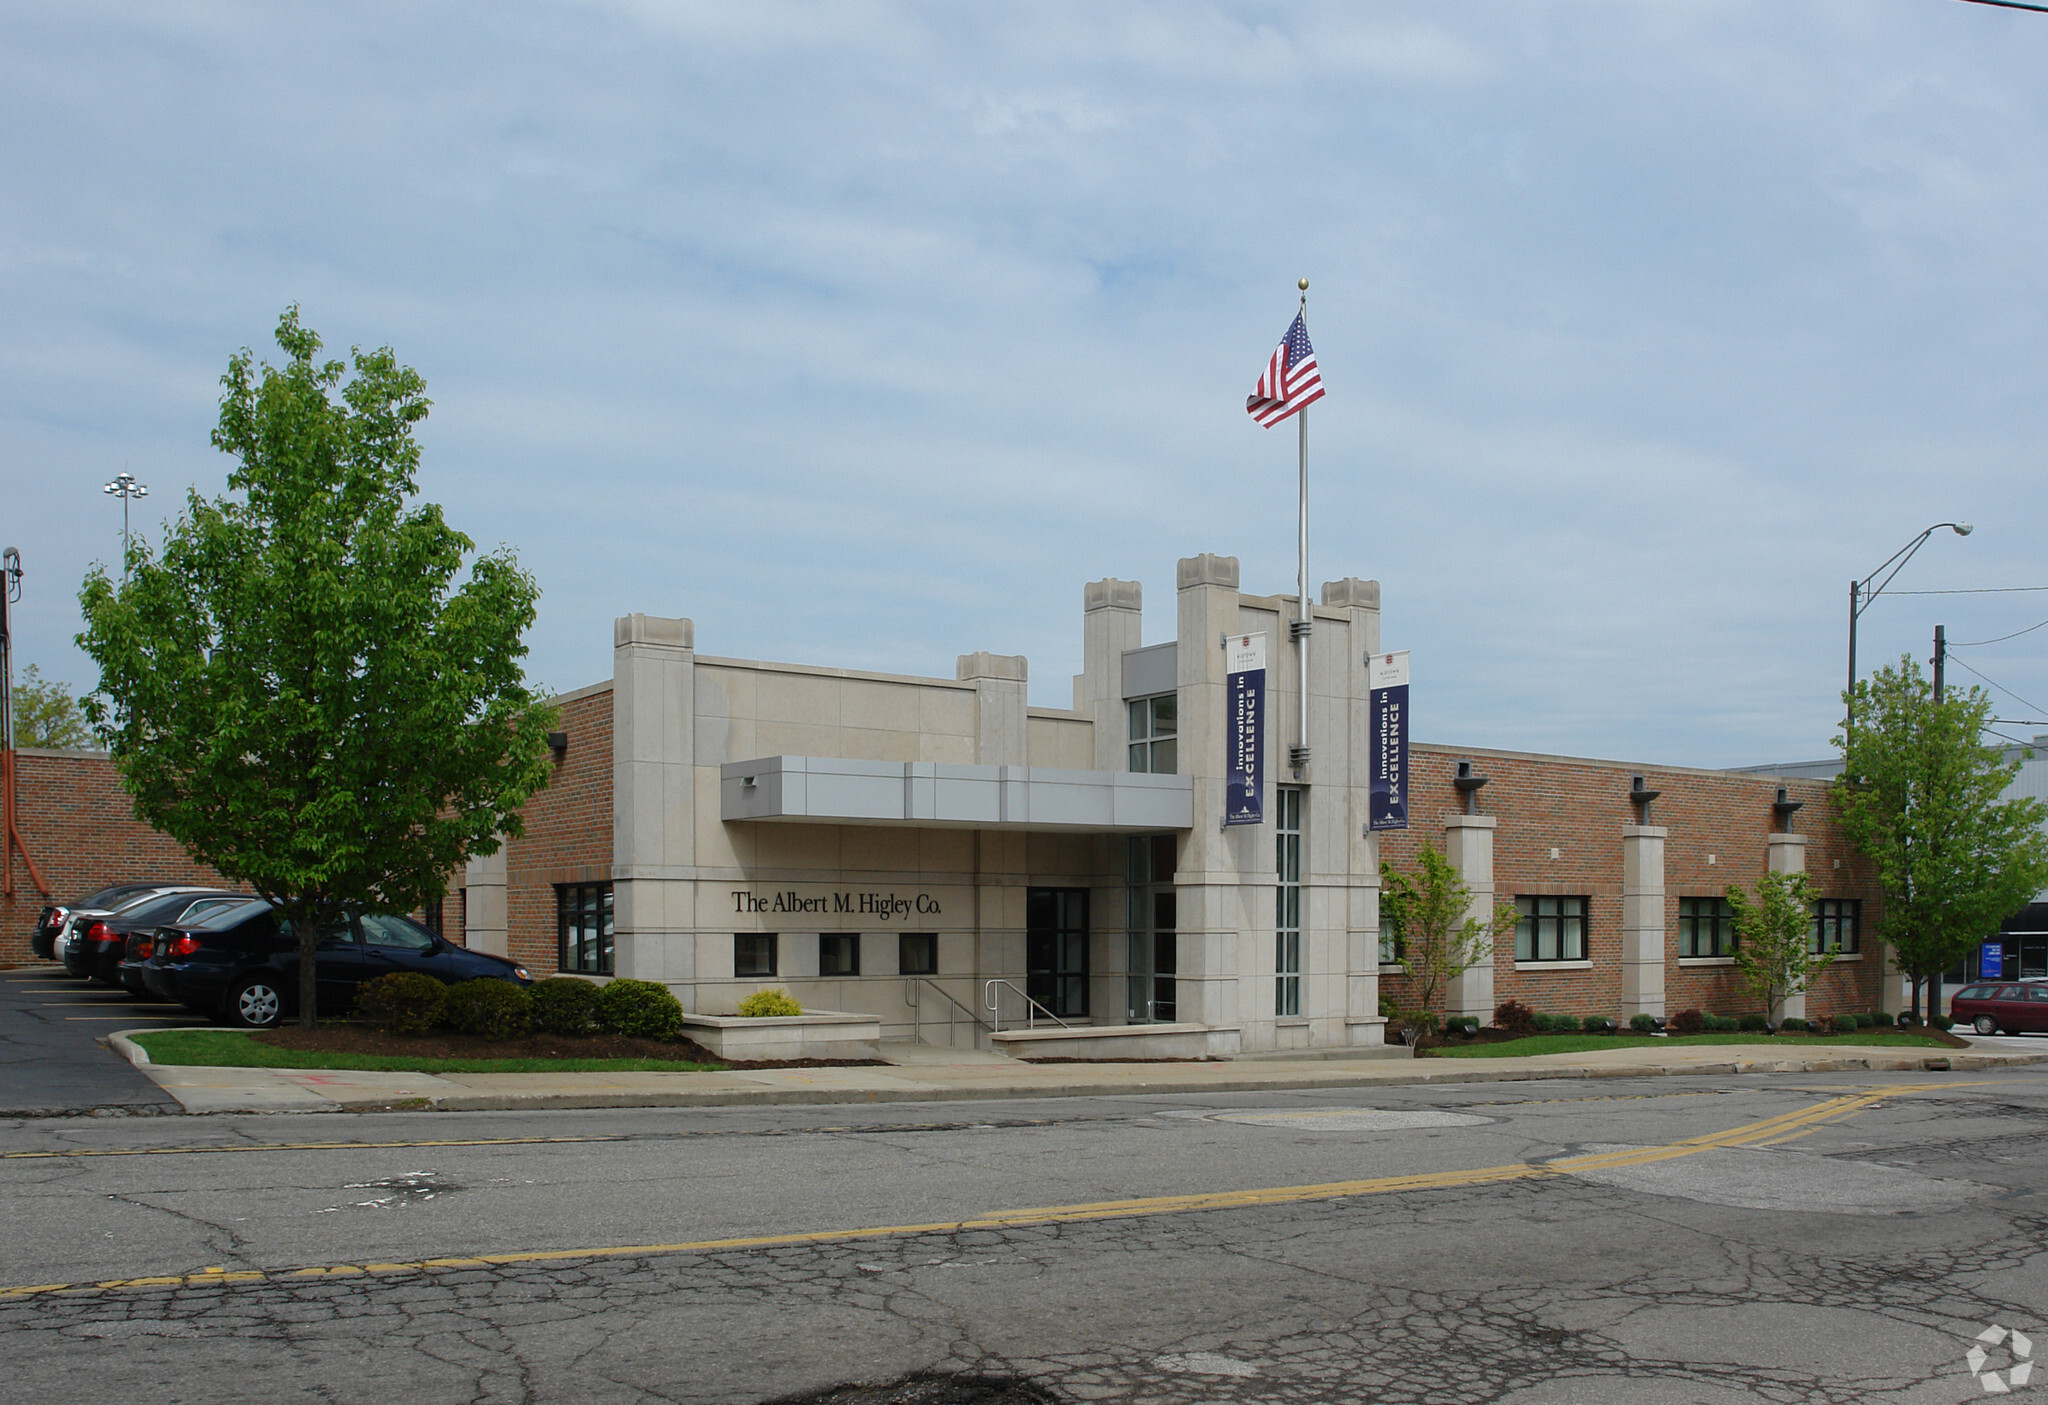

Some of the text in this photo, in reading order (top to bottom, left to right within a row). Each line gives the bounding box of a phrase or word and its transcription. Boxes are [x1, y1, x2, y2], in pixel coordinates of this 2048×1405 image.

[1236, 676, 1245, 771] innovations in
[1245, 689, 1256, 798] EXCELLENCE
[1380, 692, 1388, 780] innovations in
[1389, 703, 1400, 805] EXCELLENCE
[731, 891, 942, 921] The Albert M. Higley Co.
